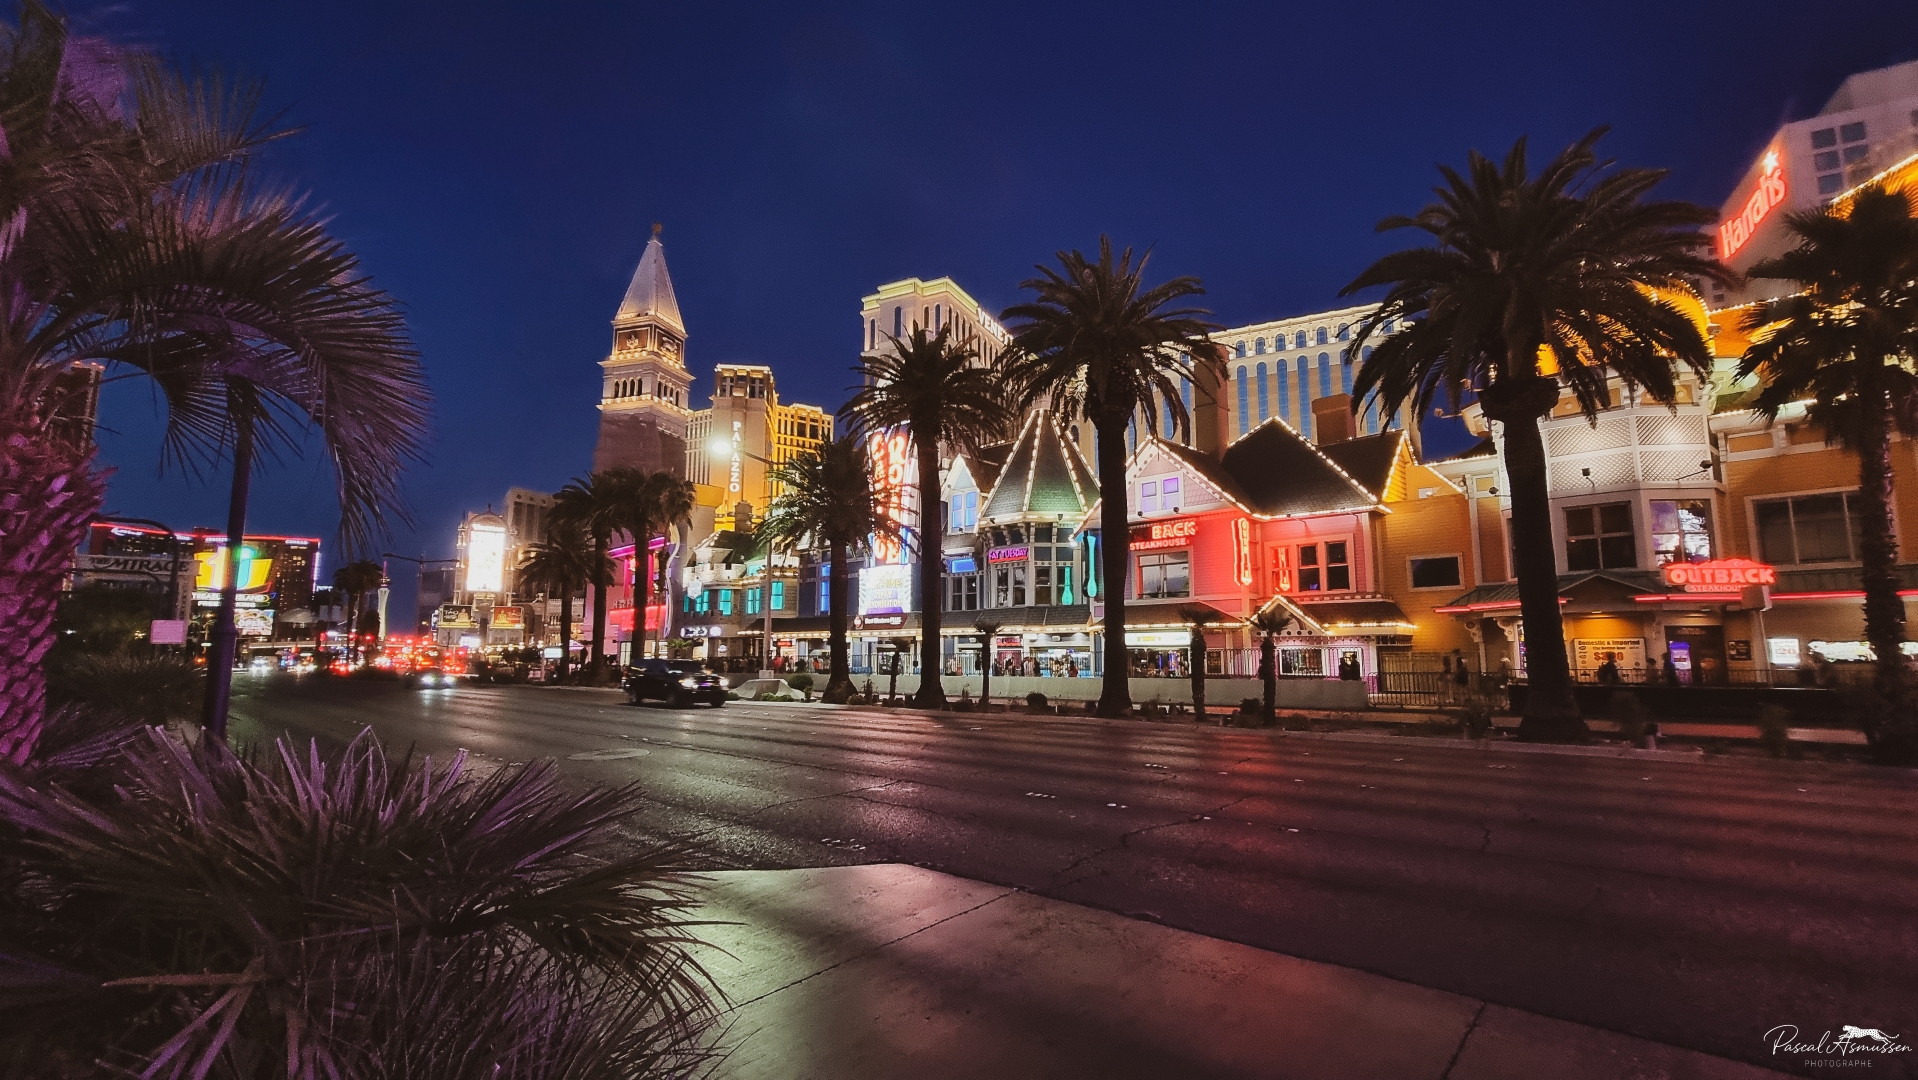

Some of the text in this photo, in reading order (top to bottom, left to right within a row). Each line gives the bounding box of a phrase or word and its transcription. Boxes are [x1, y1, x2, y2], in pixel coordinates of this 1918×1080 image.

[729, 421, 742, 493] PALAZZO
[885, 435, 906, 563] ROE
[1129, 537, 1187, 551] STEAKHOUSE
[989, 547, 1029, 560] FAT TUESDAY
[1670, 568, 1775, 584] OUTBACK
[1690, 584, 1747, 592] STEAKHOUS
[191, 592, 222, 600] TREAS
